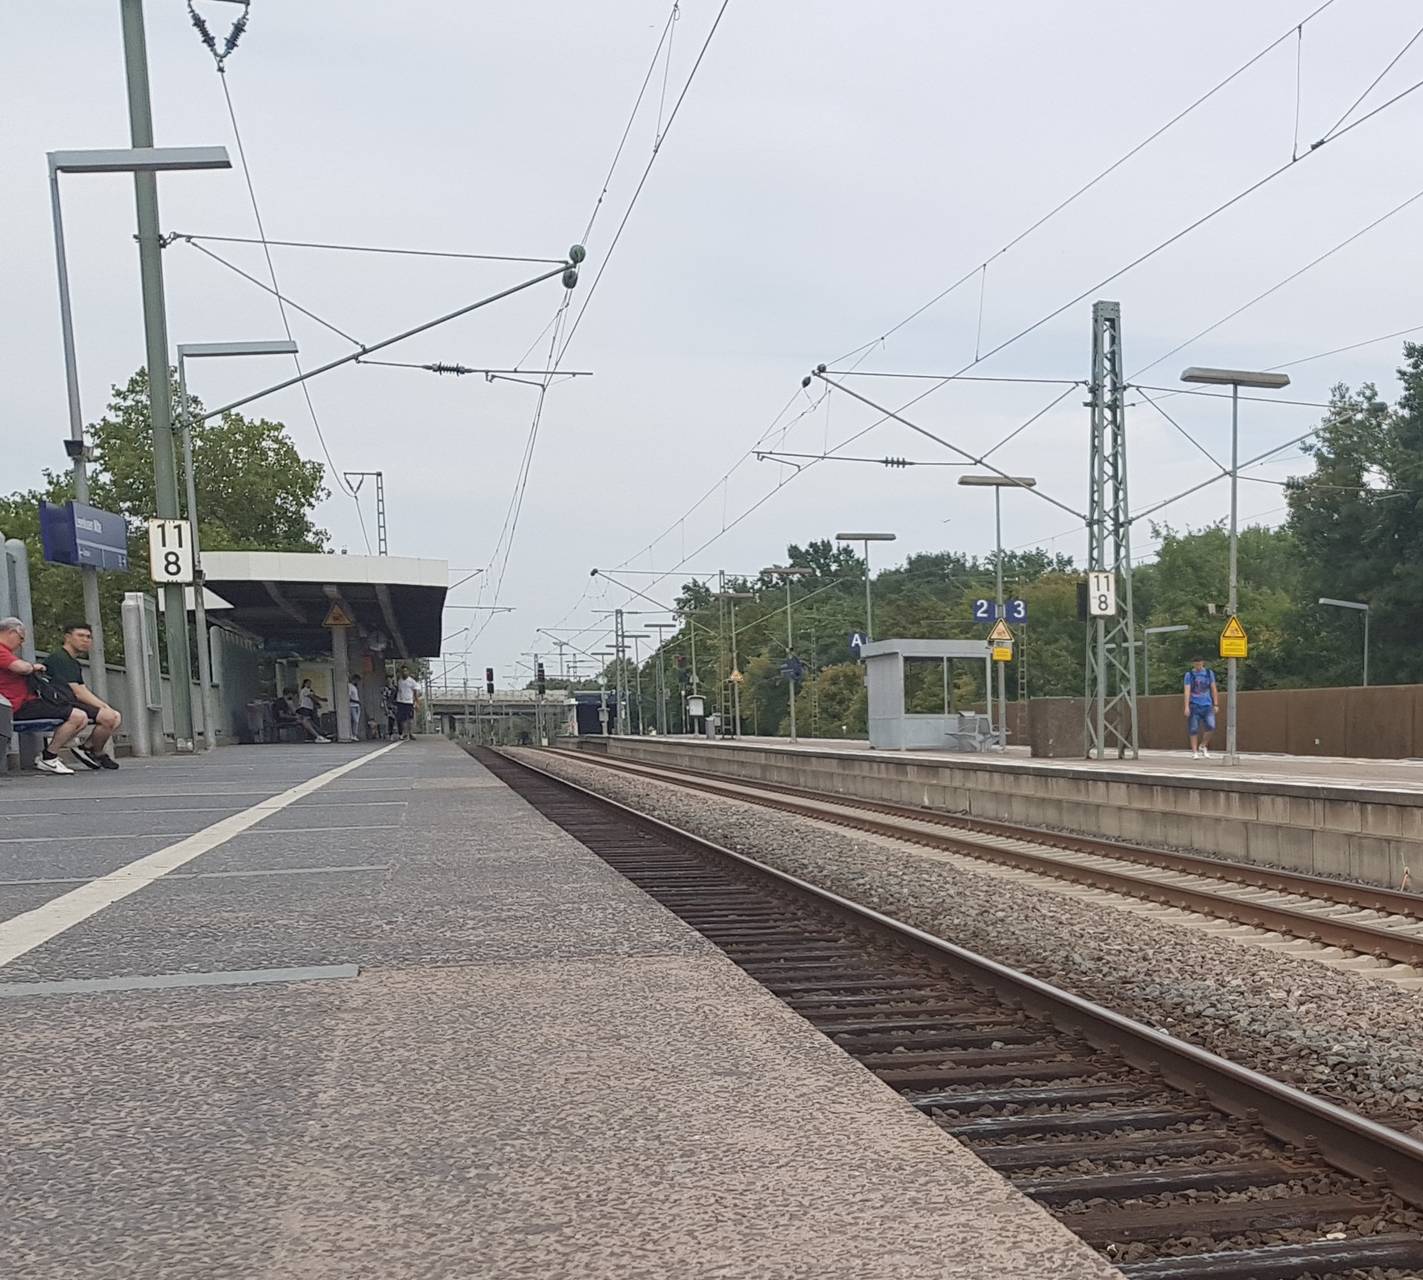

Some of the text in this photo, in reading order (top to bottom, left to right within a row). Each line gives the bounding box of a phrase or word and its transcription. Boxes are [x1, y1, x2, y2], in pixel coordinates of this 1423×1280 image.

[156, 522, 184, 549] 11
[163, 551, 182, 576] 8
[1093, 574, 1110, 593] 11
[976, 599, 989, 618] 2
[1013, 600, 1026, 618] 3
[1098, 594, 1109, 612] 8
[851, 633, 863, 648] A
